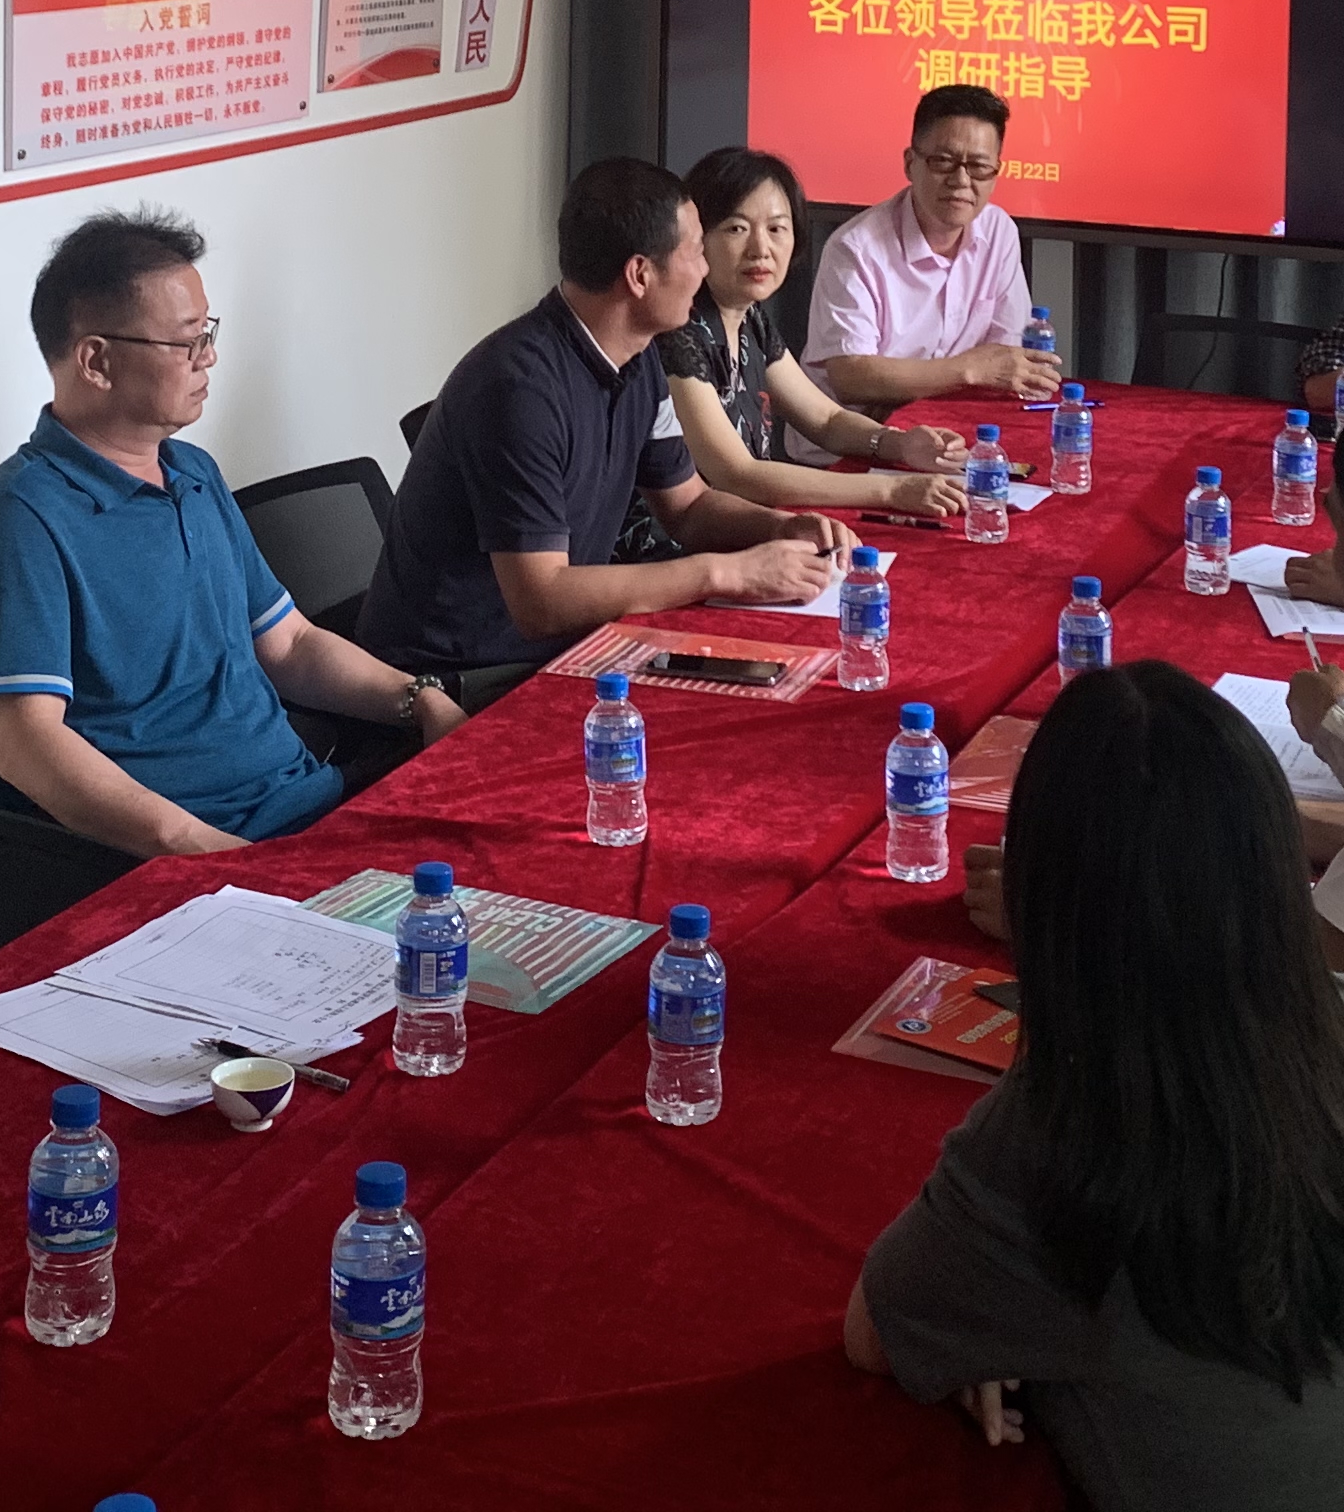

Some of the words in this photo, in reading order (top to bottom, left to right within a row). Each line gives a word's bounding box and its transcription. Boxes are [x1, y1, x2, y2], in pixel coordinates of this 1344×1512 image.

[139, 3, 212, 33] 入党誓词
[914, 49, 1092, 102] 调研指导
[474, 902, 566, 934] CLEAR
